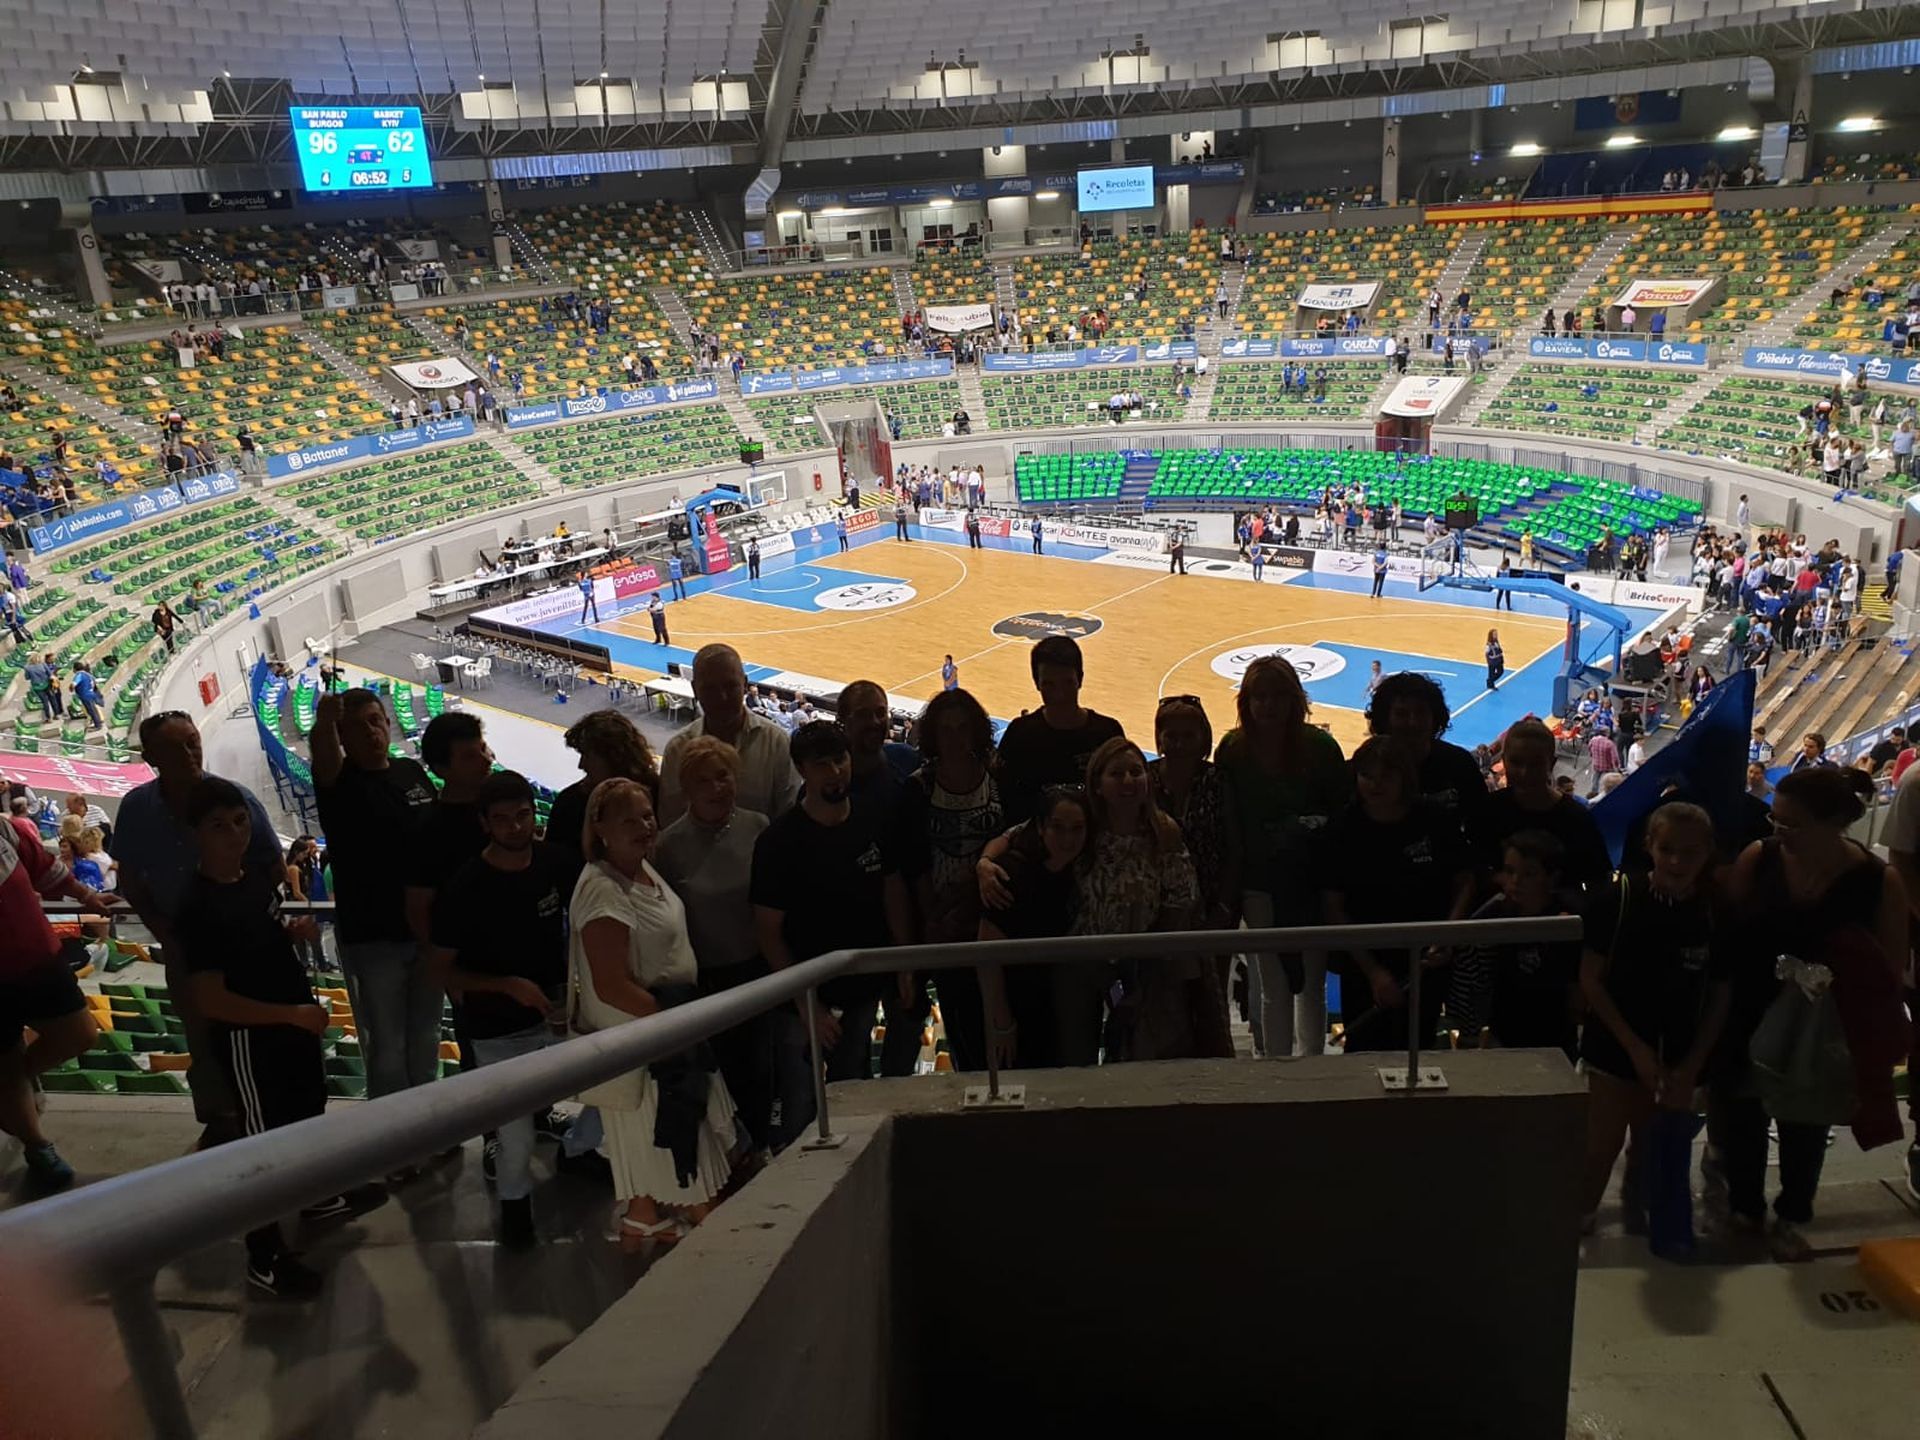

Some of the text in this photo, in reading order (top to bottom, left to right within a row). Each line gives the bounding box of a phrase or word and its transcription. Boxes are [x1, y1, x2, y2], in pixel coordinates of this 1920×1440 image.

[301, 110, 348, 119] SAN PABLO
[373, 110, 404, 119] BASKET
[309, 120, 344, 128] BURGOS
[381, 119, 400, 128] KYIV
[309, 131, 338, 154] 96
[387, 131, 415, 153] 62
[321, 172, 330, 185] 4
[352, 171, 388, 185] 06:52
[402, 170, 411, 182] 5
[1105, 179, 1146, 189] Recoletas
[80, 234, 96, 250] G
[1637, 290, 1691, 300] Pascual
[845, 511, 878, 529] URGOS
[1060, 526, 1107, 542] KOMTES
[613, 568, 657, 589] endesa
